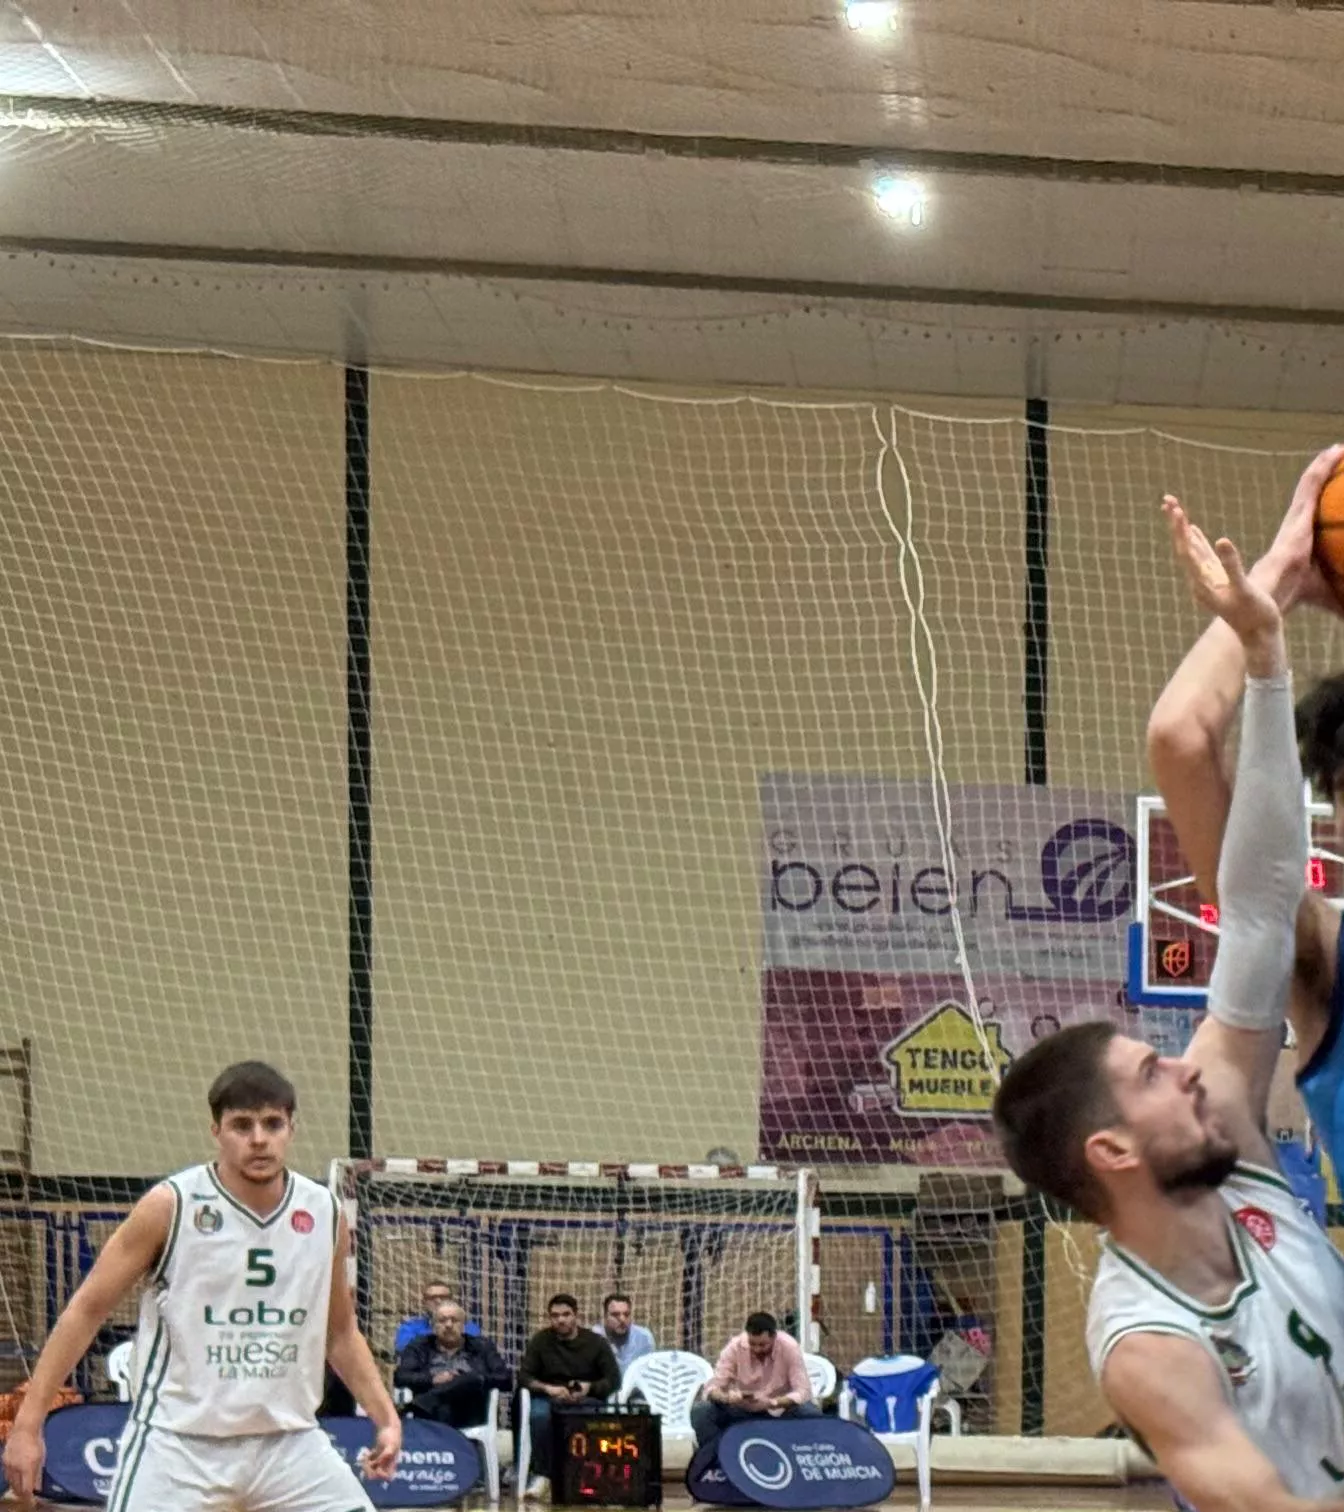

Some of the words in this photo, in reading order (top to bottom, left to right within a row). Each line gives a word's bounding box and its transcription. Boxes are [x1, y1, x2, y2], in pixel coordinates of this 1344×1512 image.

[778, 1132, 862, 1151] ARCHENA
[245, 1248, 276, 1288] 5
[823, 1465, 883, 1481] MURCIA
